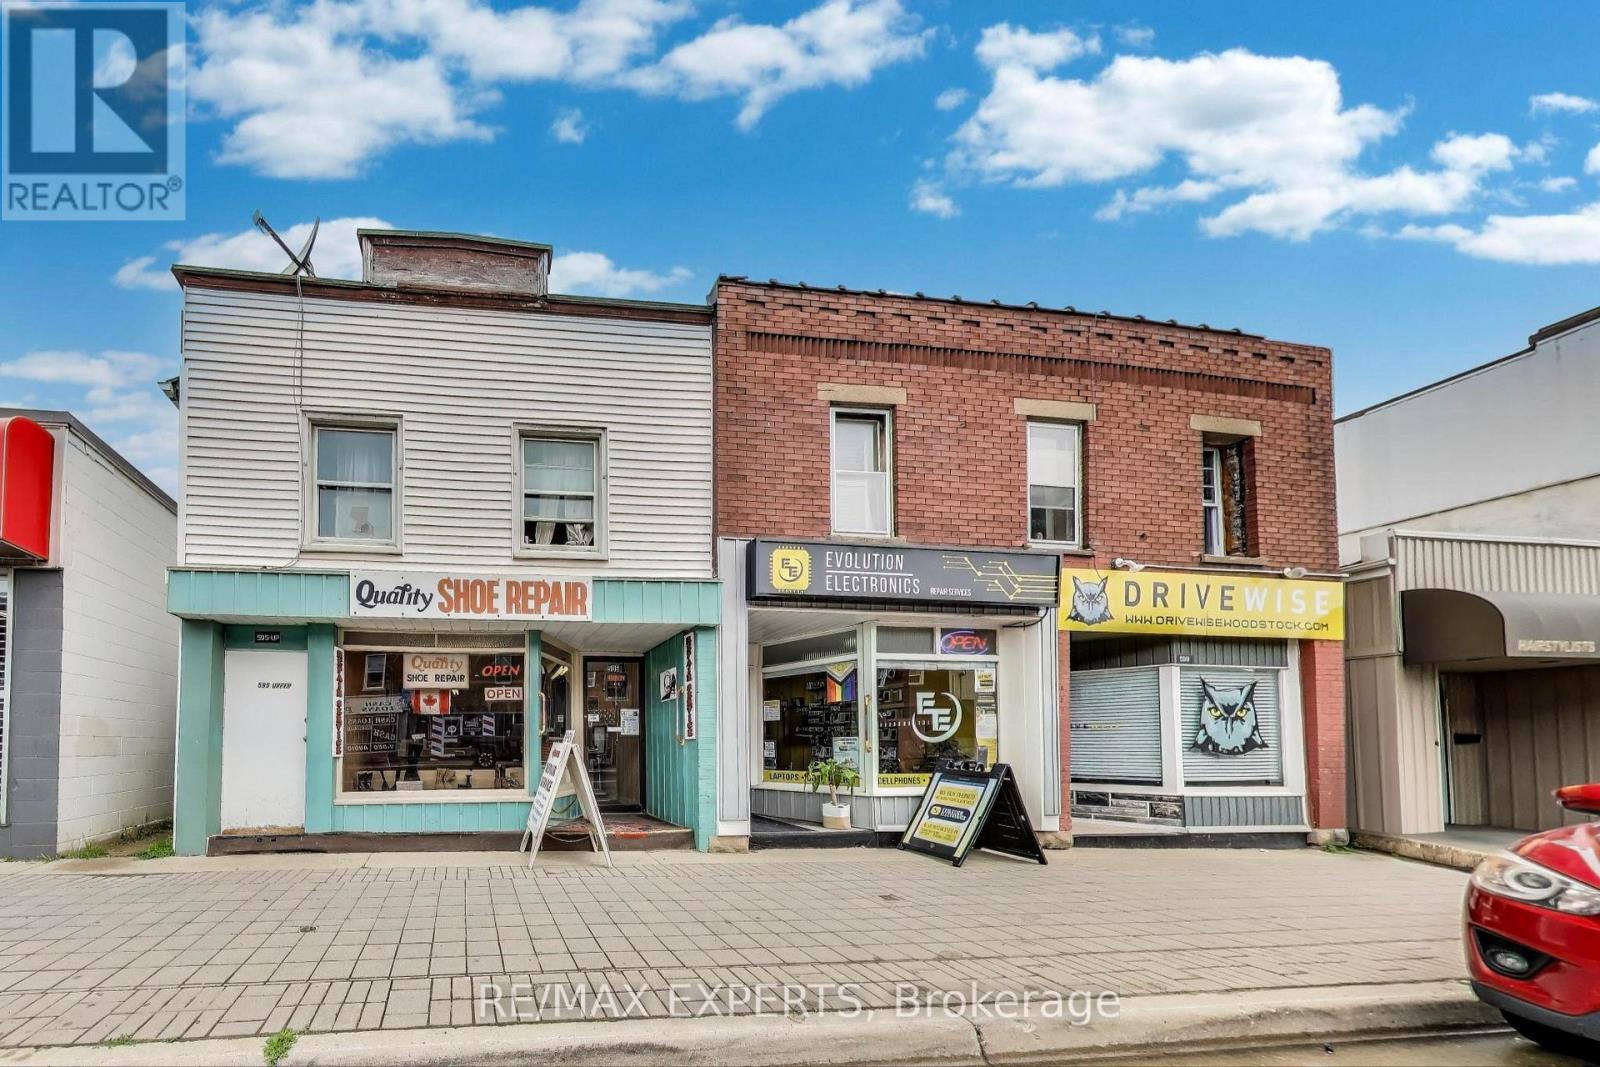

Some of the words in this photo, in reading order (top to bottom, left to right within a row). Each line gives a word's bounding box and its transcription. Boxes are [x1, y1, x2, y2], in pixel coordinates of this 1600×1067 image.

[826, 551, 904, 571] EVOLUTION
[826, 574, 921, 594] ELECTRONICS
[355, 579, 433, 612] Quality
[437, 576, 499, 614] SHOE
[505, 579, 588, 615] REPAIR
[930, 587, 948, 596] REPAIR
[949, 588, 971, 597] SERVICES
[1125, 614, 1329, 631] WWW.DRIVEWISEWOODSTOCK.COM
[411, 655, 463, 672] Quality
[482, 664, 521, 677] OPEN
[407, 673, 428, 682] SHOE
[434, 673, 466, 682] REPAIR
[486, 688, 520, 699] OPEN
[769, 772, 799, 782] LAPTOPS
[878, 774, 921, 785] CELLPHONES
